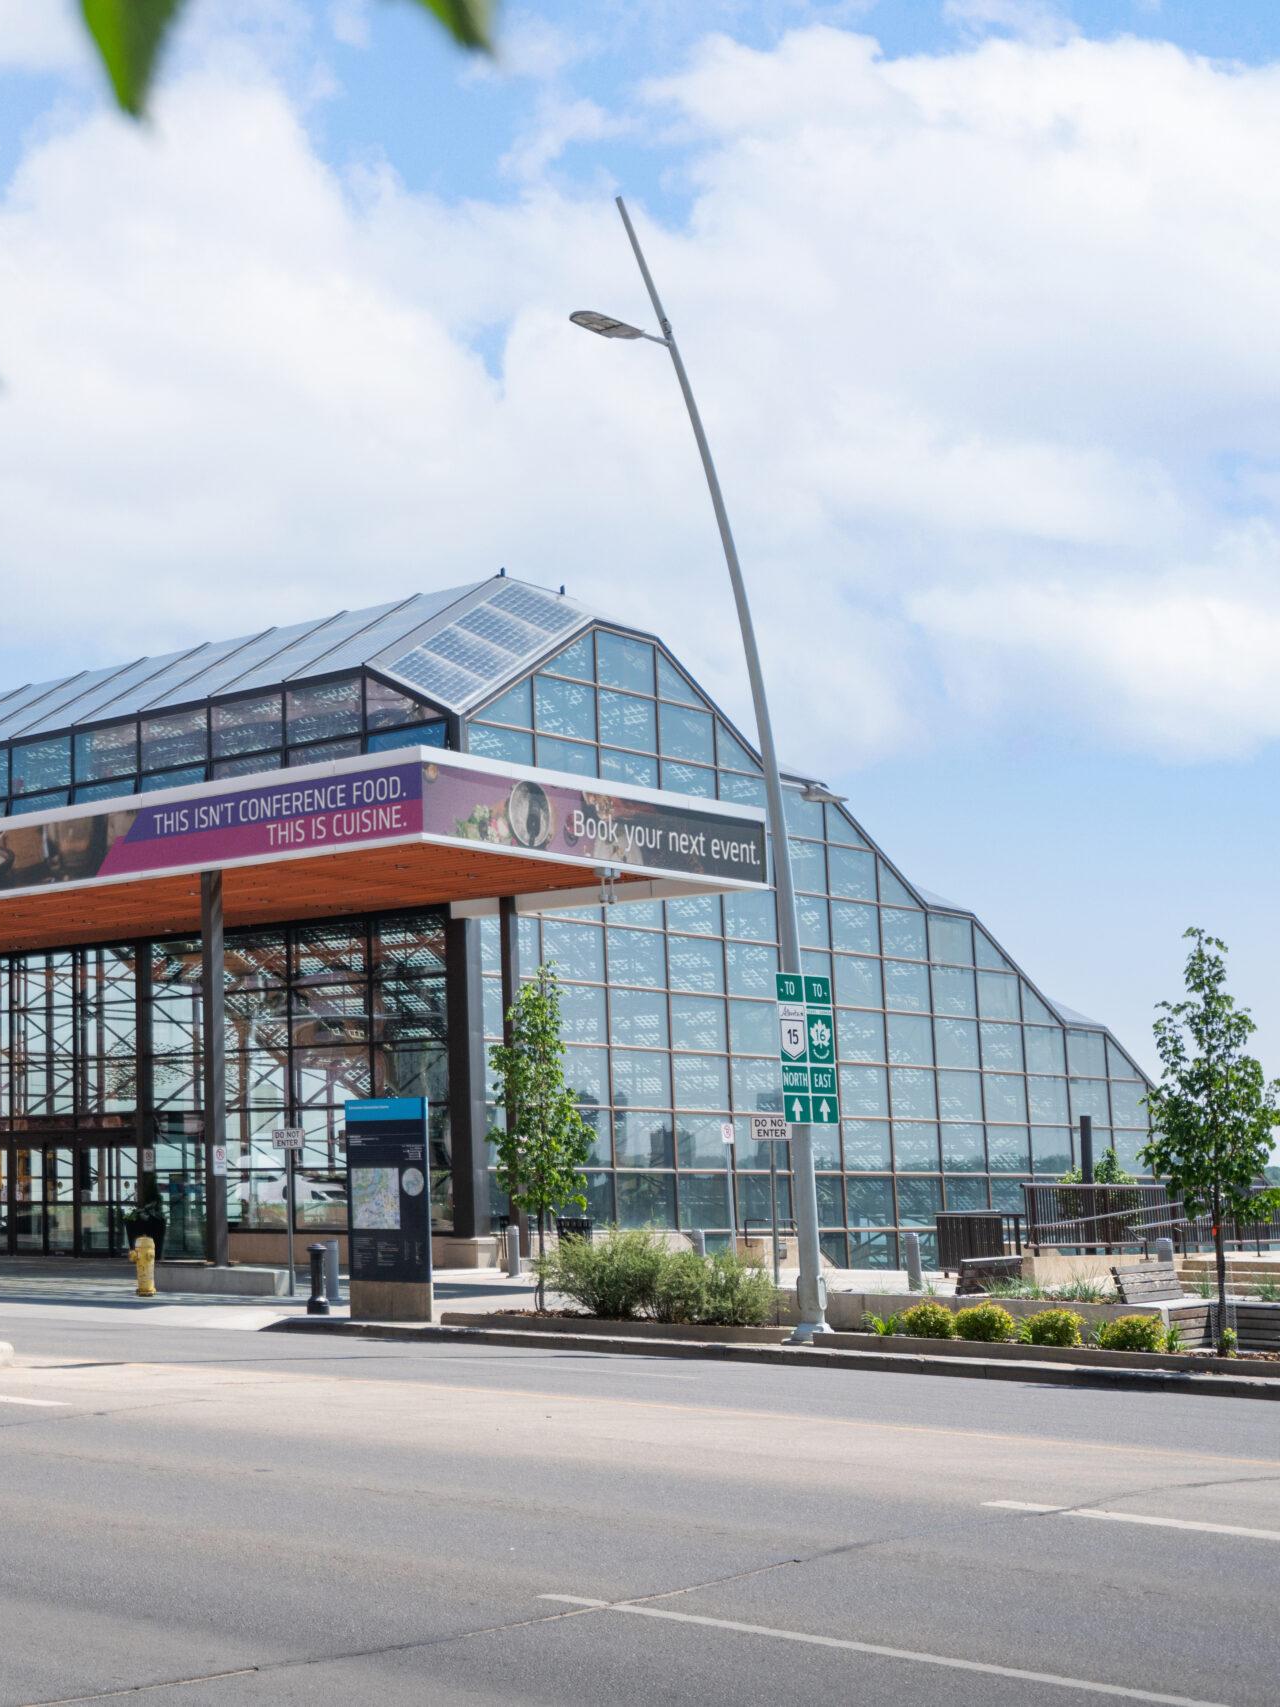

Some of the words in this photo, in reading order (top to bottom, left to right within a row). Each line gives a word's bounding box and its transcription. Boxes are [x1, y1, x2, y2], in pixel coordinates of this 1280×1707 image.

[153, 809, 189, 835] THIS
[194, 803, 235, 829] ISN'T
[239, 784, 347, 823] CONFERENCE
[352, 776, 407, 805] FOOD.
[266, 819, 305, 846] THIS
[311, 816, 327, 840] IS
[332, 805, 408, 837] CUISINE.
[573, 809, 619, 843] Book
[624, 823, 663, 852] your
[669, 832, 706, 857] next
[711, 838, 761, 865] event.
[784, 981, 795, 996] TO
[812, 983, 822, 998] TO
[787, 1028, 799, 1045] 15
[815, 1029, 826, 1042] 16
[783, 1072, 808, 1088] NORTH
[814, 1073, 832, 1088] EAST
[754, 1118, 767, 1127] DO
[274, 1131, 285, 1139] DO
[286, 1130, 300, 1138] NOT
[757, 1128, 787, 1137] ENTER
[277, 1139, 299, 1147] ENTER
